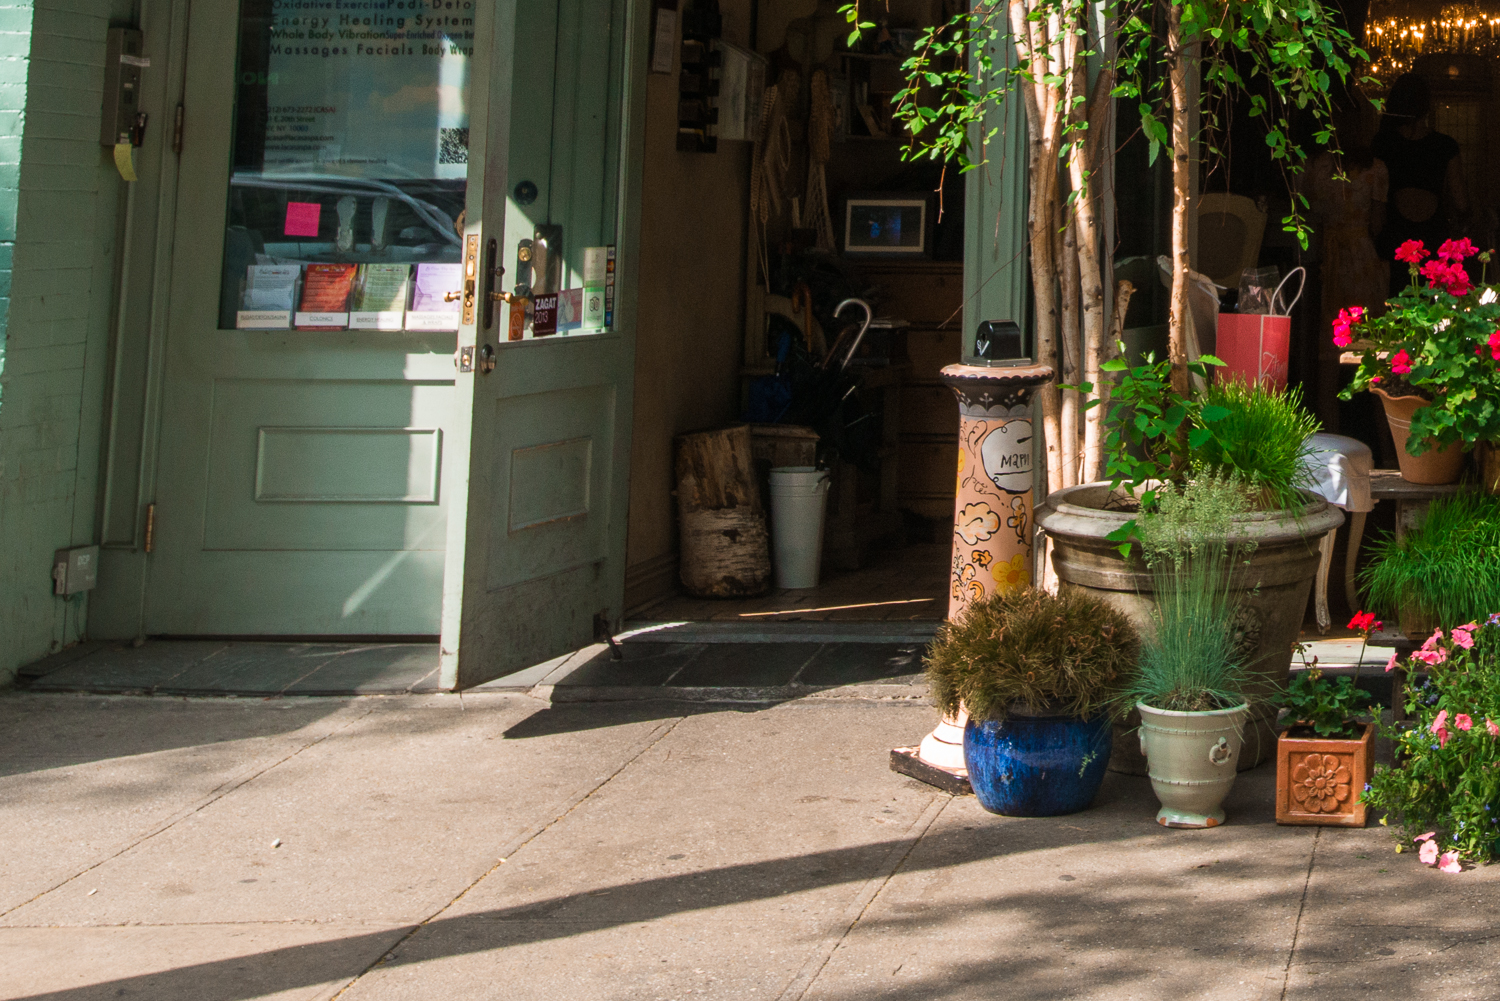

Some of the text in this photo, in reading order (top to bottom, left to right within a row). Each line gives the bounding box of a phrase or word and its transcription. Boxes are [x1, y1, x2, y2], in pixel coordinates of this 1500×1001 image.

[336, 0, 385, 9] Exercise
[271, 14, 329, 28] Energy
[339, 14, 405, 29] Healing
[271, 30, 304, 39] Whole
[308, 30, 334, 41] Body
[338, 30, 385, 39] Vibration
[270, 44, 348, 57] Massages
[357, 43, 413, 55] Facials
[422, 44, 445, 57] Body
[535, 297, 557, 310] ZAGAT
[534, 311, 548, 324] 2013
